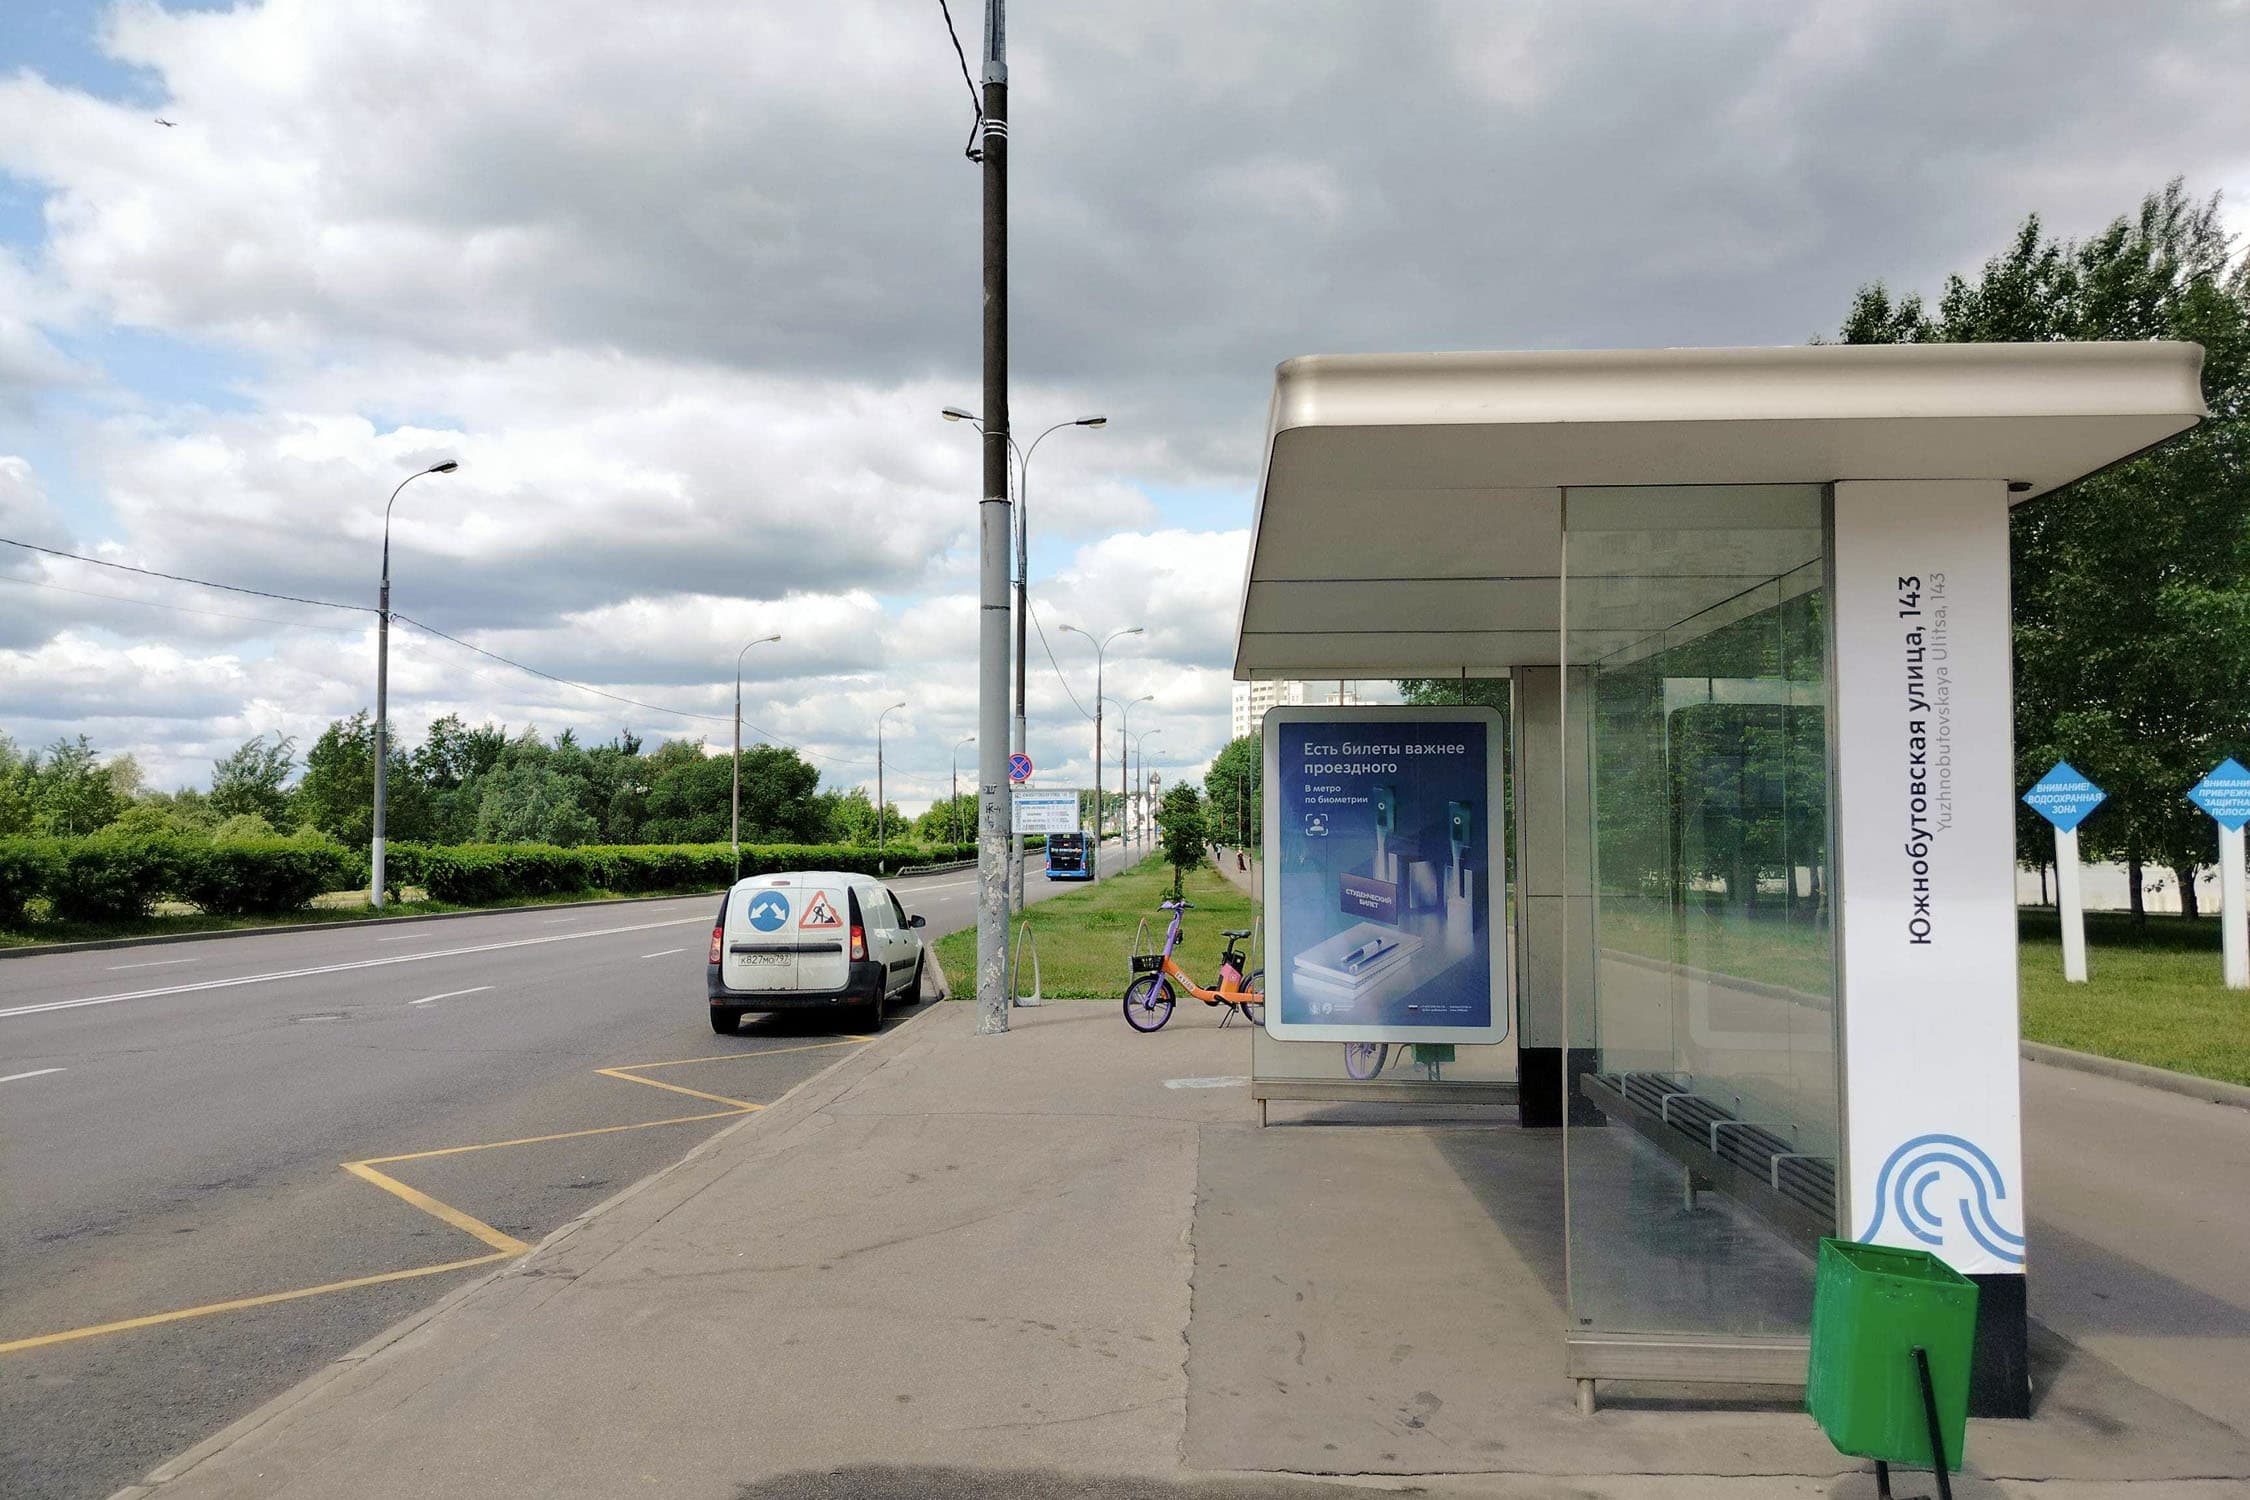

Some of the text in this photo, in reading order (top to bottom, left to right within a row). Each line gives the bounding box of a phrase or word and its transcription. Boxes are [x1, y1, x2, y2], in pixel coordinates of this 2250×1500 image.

[1930, 572, 1952, 833] Yuzhnobutovskaya Ulitsa, 143
[1304, 742, 1465, 756] Есть билеты важнее
[1898, 576, 1933, 944] Южнобутовская улица, 143
[1304, 762, 1398, 777] проездного
[1304, 784, 1342, 795] В метро
[2036, 782, 2090, 793] ВНИМАНИЕ!
[1318, 795, 1369, 805] биометрии
[2027, 793, 2102, 806] ВОДООХРАННАЯ
[2051, 804, 2077, 815] ЗОНА
